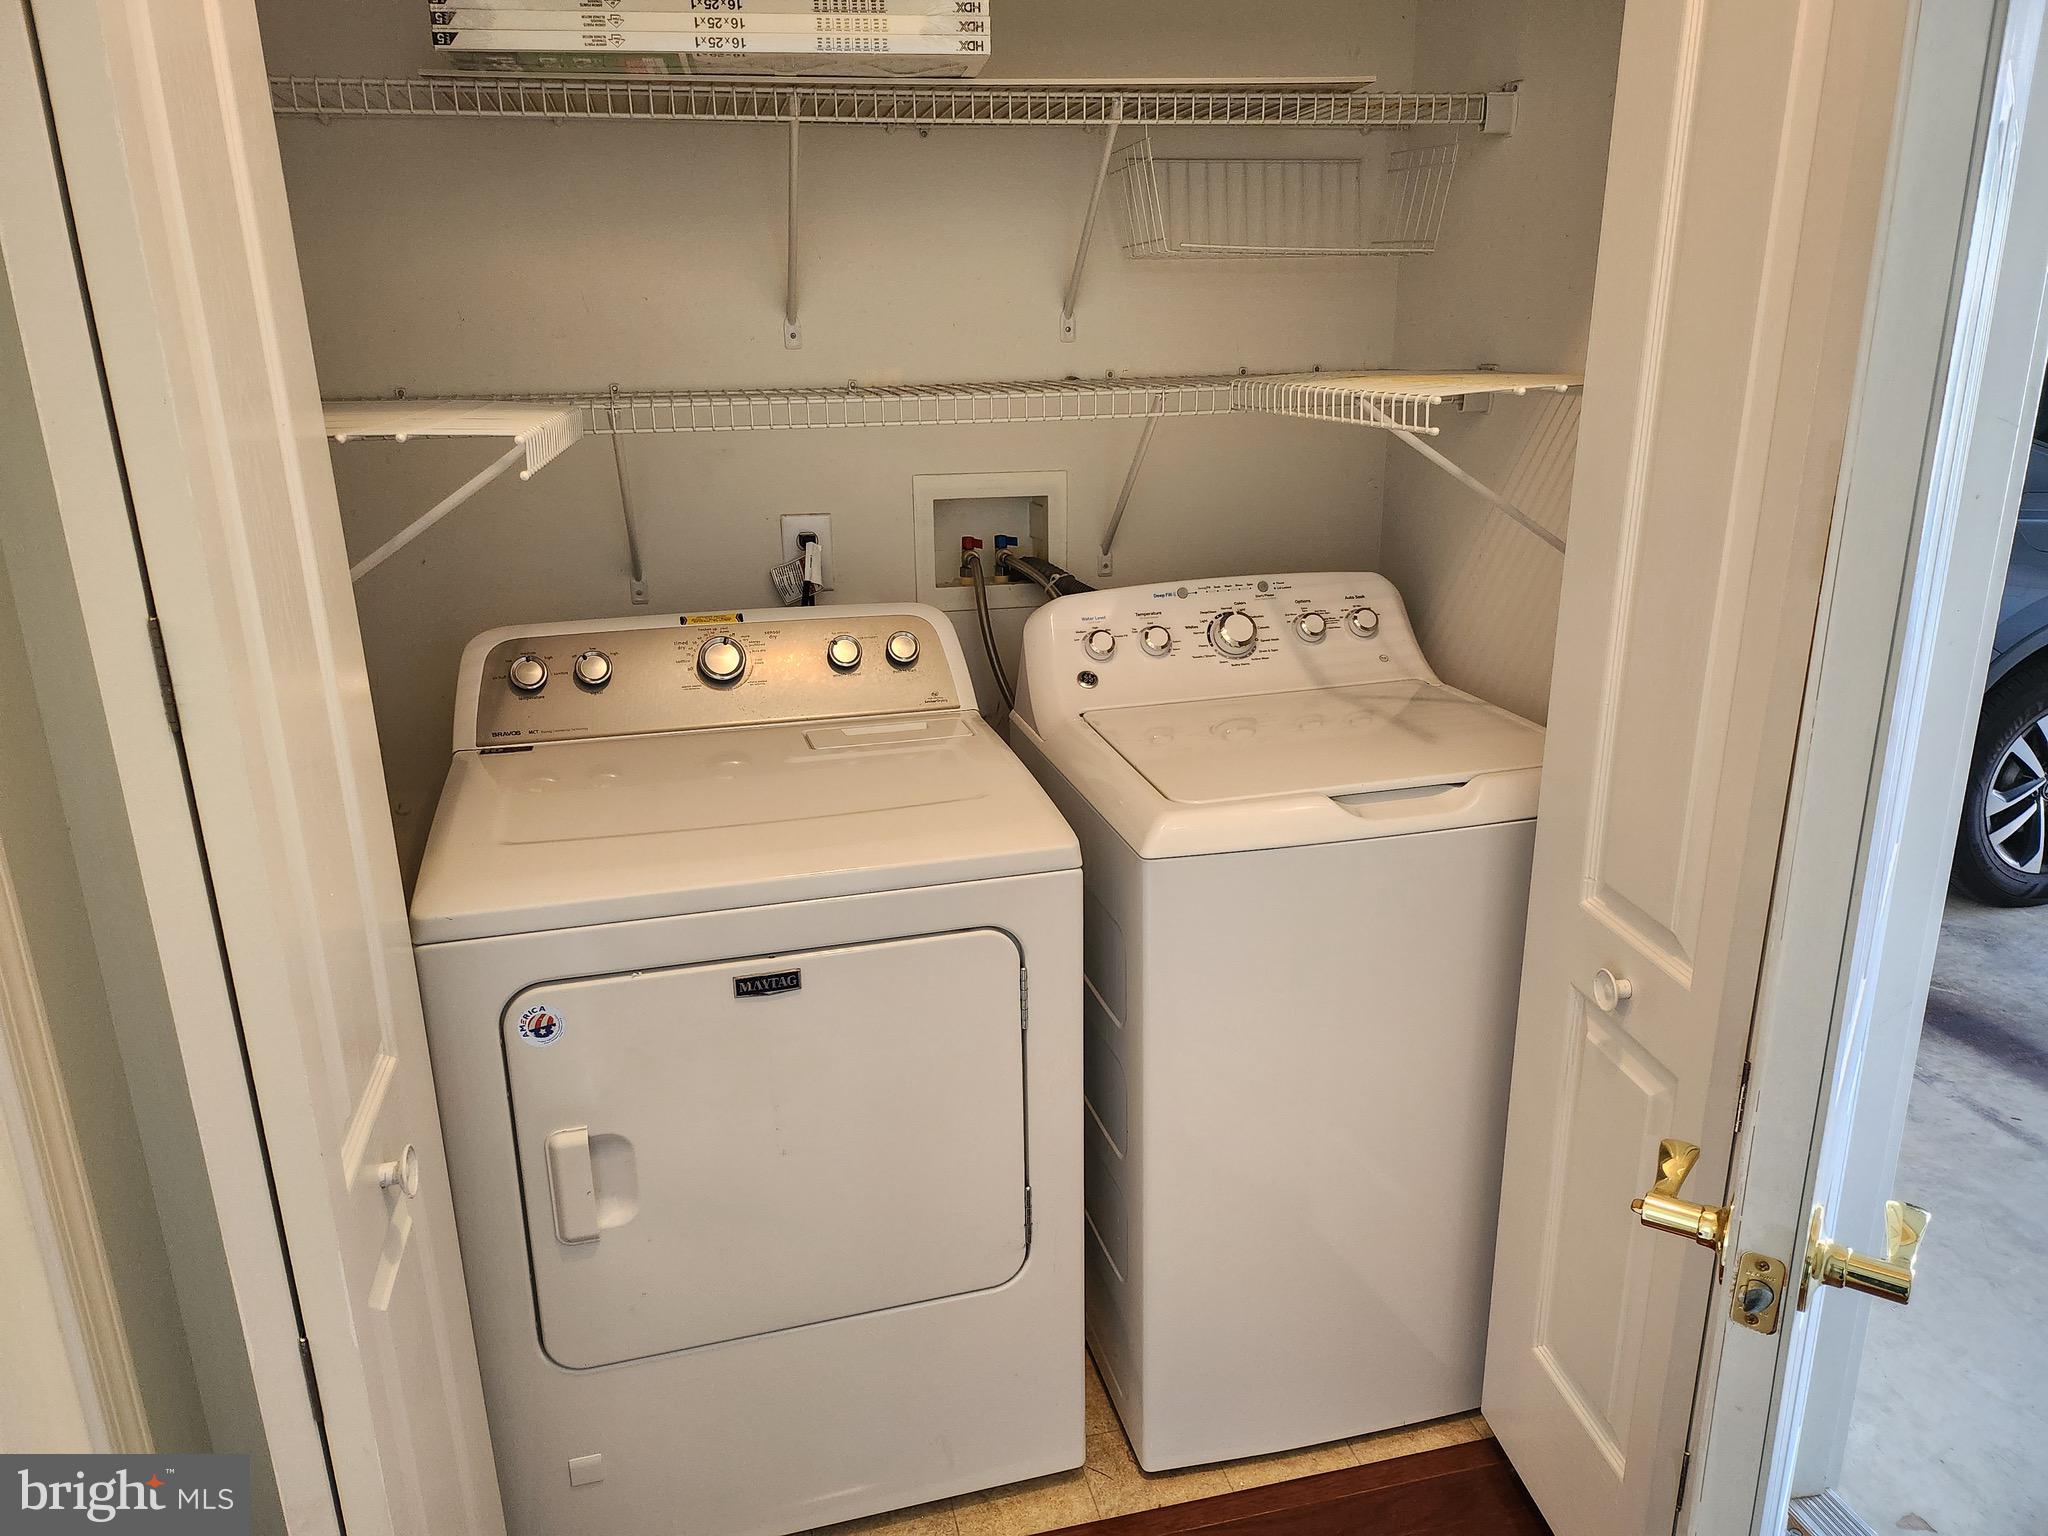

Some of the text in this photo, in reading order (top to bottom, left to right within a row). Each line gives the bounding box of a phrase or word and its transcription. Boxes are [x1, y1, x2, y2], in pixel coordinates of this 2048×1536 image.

[956, 2, 981, 13] HDX
[958, 21, 984, 32] HDX
[958, 40, 984, 51] HDX
[491, 730, 521, 738] BRAVOS
[738, 974, 798, 994] MAYTAG
[519, 1005, 546, 1038] AMERICA
